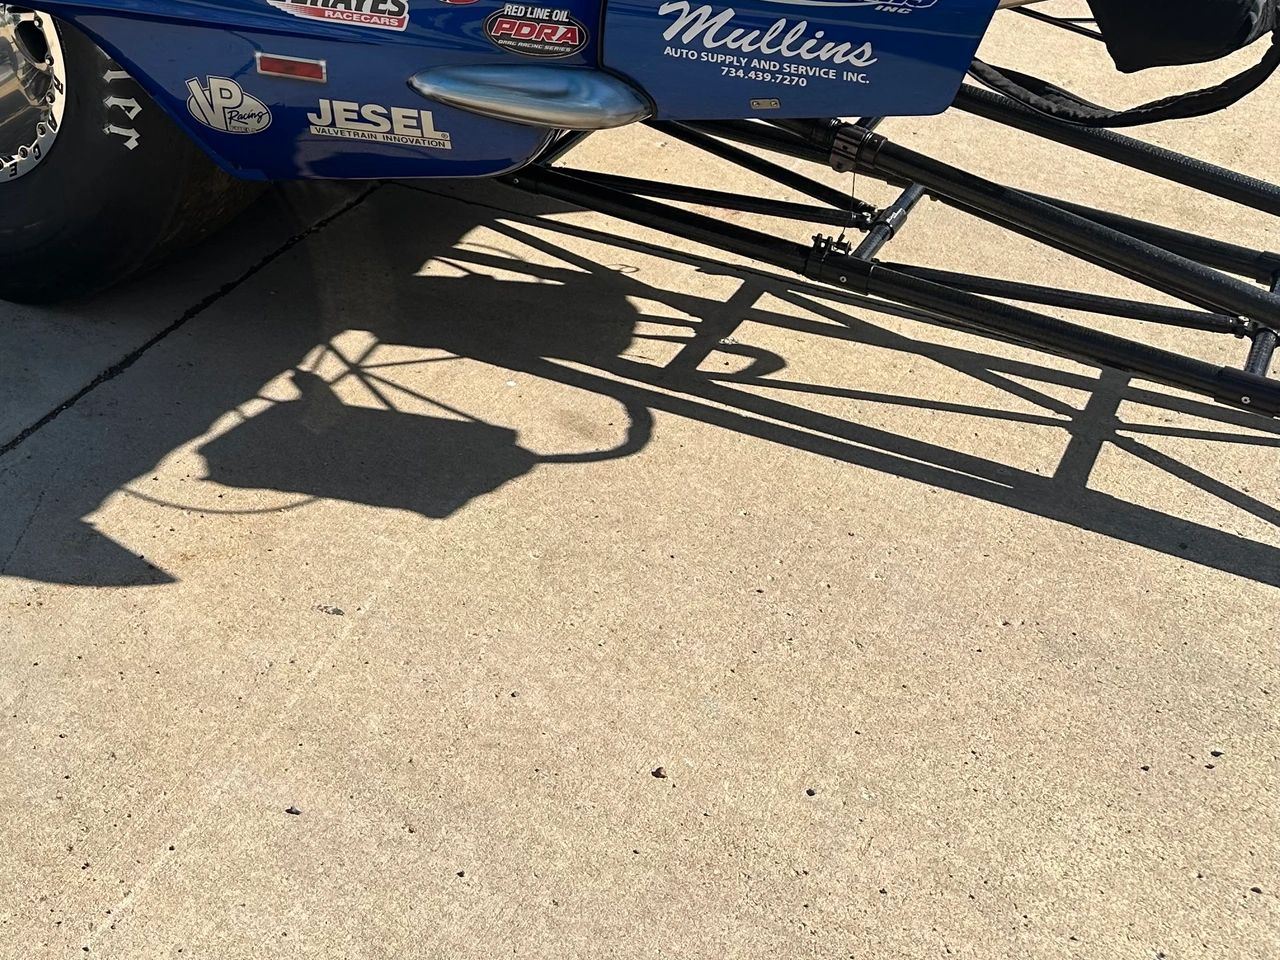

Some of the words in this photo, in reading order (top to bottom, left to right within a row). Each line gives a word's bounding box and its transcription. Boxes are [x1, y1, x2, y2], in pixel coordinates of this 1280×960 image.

[324, 10, 399, 26] RACECARS
[504, 4, 527, 17] RED
[527, 7, 550, 20] LINE
[552, 10, 570, 22] OIL
[874, 4, 913, 15] INC
[491, 18, 580, 46] PDRA
[658, 0, 878, 67] Mullins
[517, 42, 544, 50] RACING
[664, 46, 698, 60] AUTO
[701, 52, 748, 66] SUPPLY
[751, 58, 780, 72] AND
[783, 63, 837, 80] SERVICE
[843, 71, 870, 85] INC.
[721, 66, 807, 87] 734.439.7270
[185, 75, 244, 131] VP
[227, 109, 268, 125] Racing
[306, 98, 443, 138] JESEL
[315, 127, 377, 141] VALVETRAIN
[382, 134, 446, 148] INNOVATION
